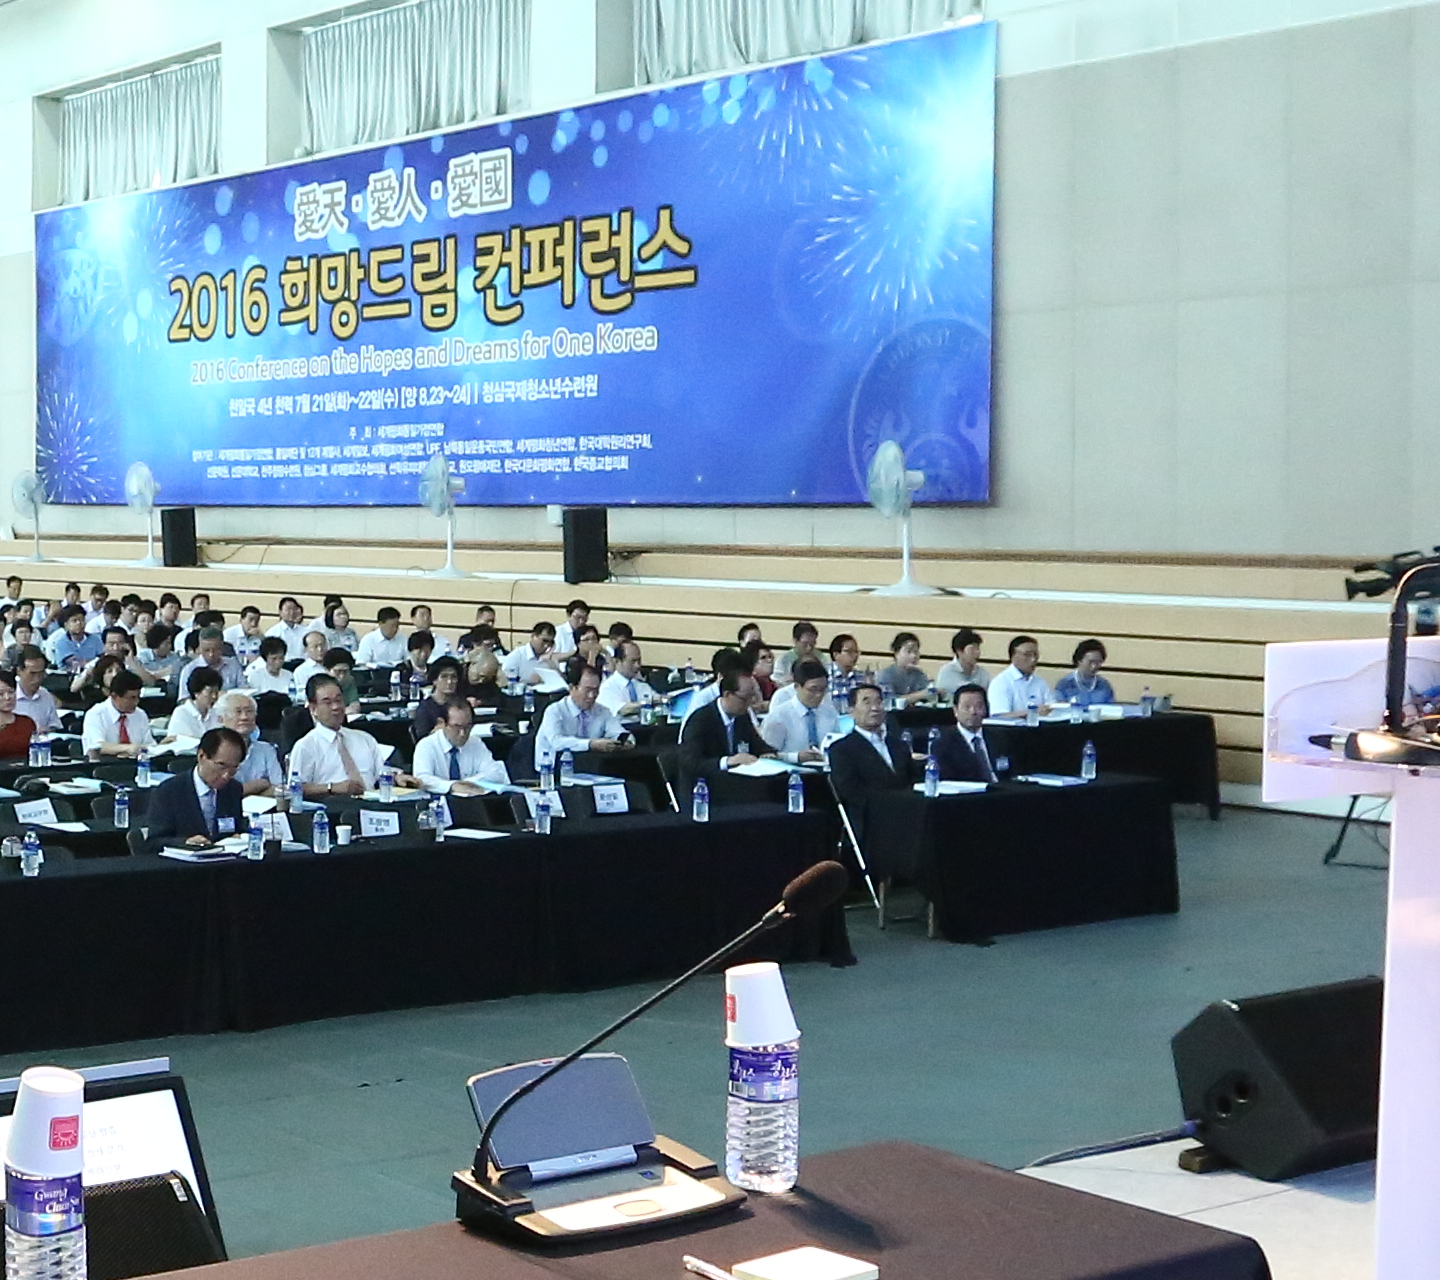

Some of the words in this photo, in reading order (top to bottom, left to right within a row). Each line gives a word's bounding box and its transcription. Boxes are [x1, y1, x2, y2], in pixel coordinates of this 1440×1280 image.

[168, 267, 269, 342] 2016
[279, 237, 458, 340] 희망드림
[474, 206, 696, 327] 컨퍼런스
[192, 360, 225, 384] 2016
[227, 355, 308, 381] Conference
[309, 356, 329, 375] on
[331, 347, 358, 372] the
[360, 345, 412, 376] Hopes
[416, 338, 449, 368] and
[452, 337, 520, 364] Dreams
[522, 330, 551, 358] for
[552, 327, 594, 356] One
[596, 323, 658, 353] Korea
[295, 393, 311, 413] 7월
[482, 374, 599, 403] 청심국제청소년수련원
